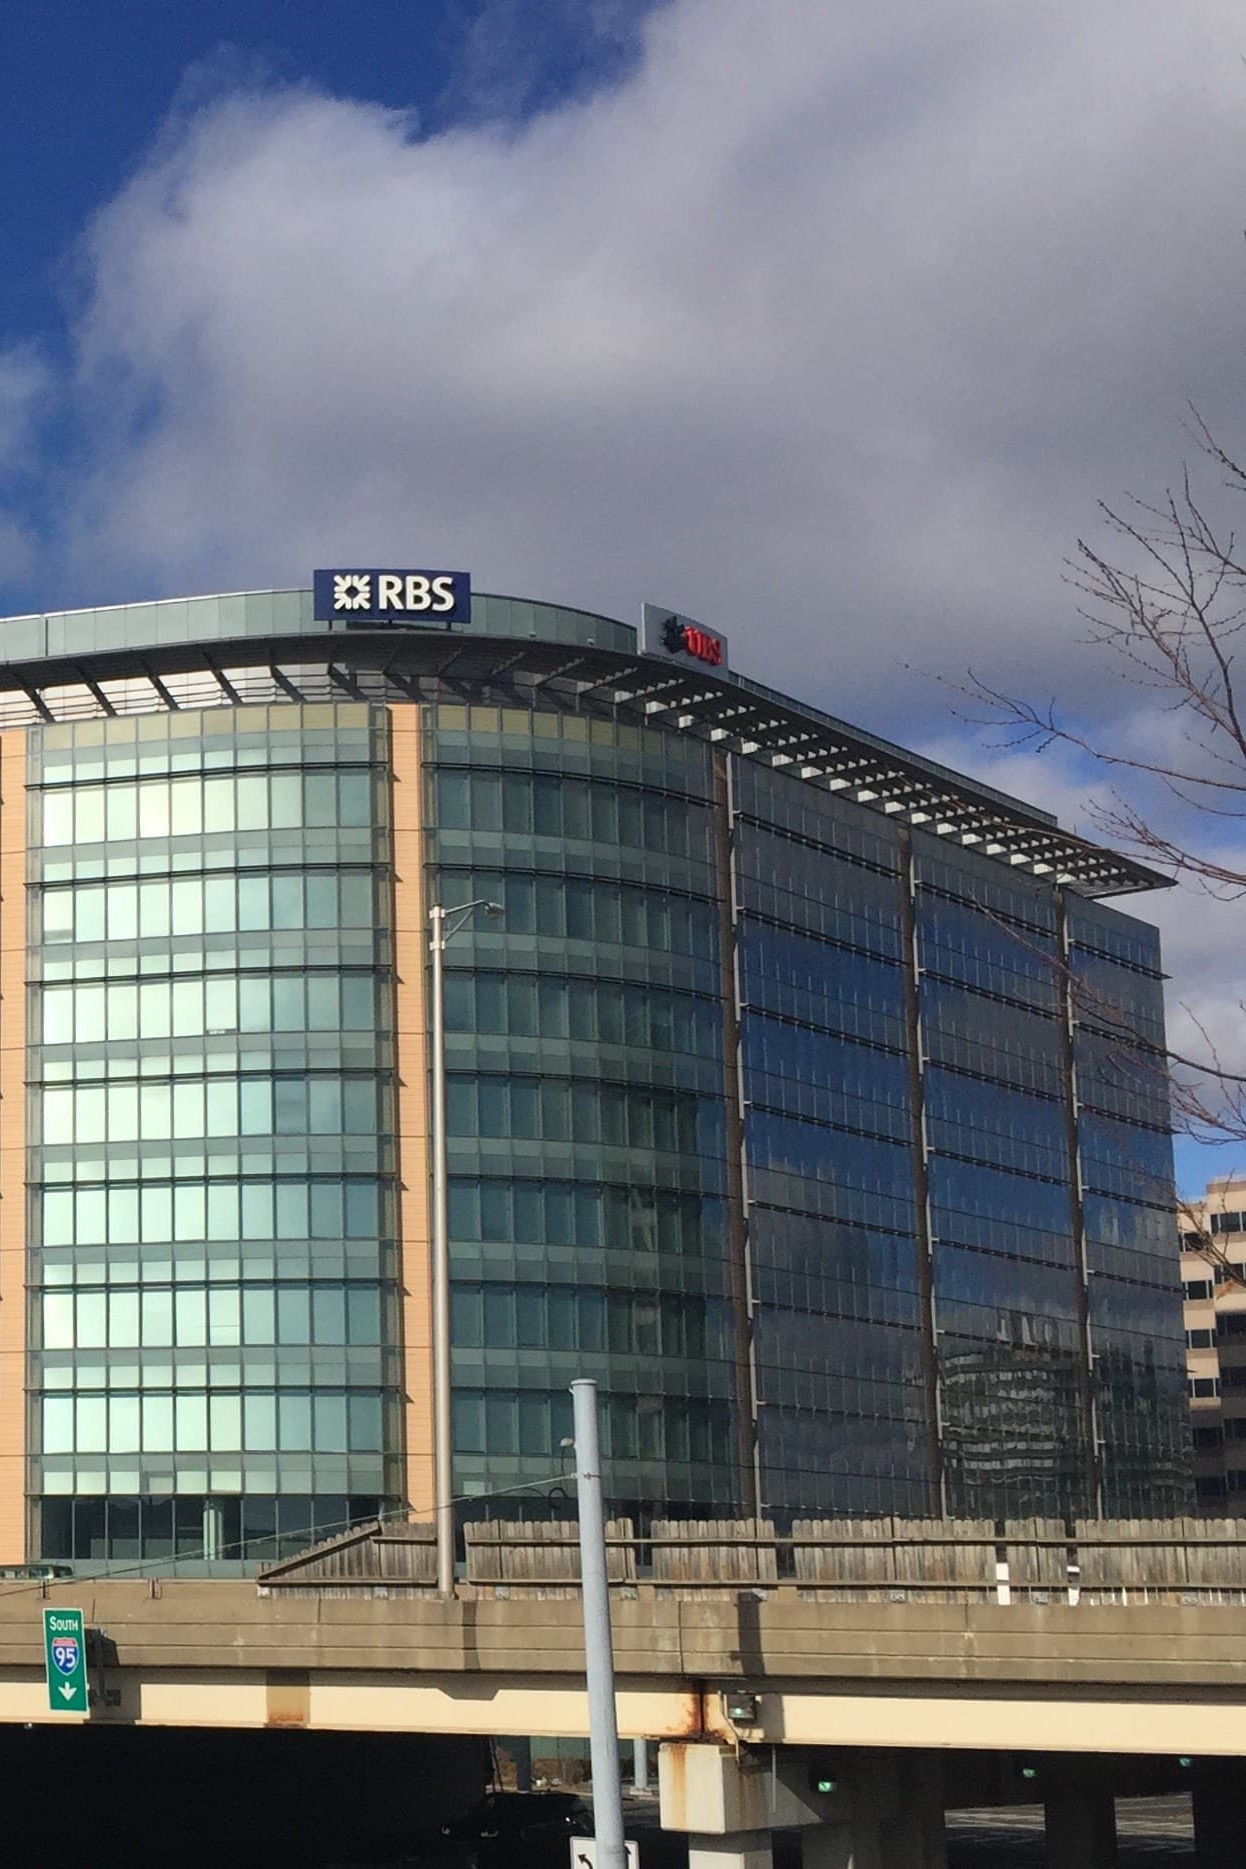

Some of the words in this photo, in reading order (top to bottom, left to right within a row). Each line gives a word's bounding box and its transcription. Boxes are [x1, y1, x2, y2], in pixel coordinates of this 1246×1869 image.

[379, 575, 454, 611] RBS
[684, 625, 722, 665] UBS
[55, 1647, 76, 1668] 95
